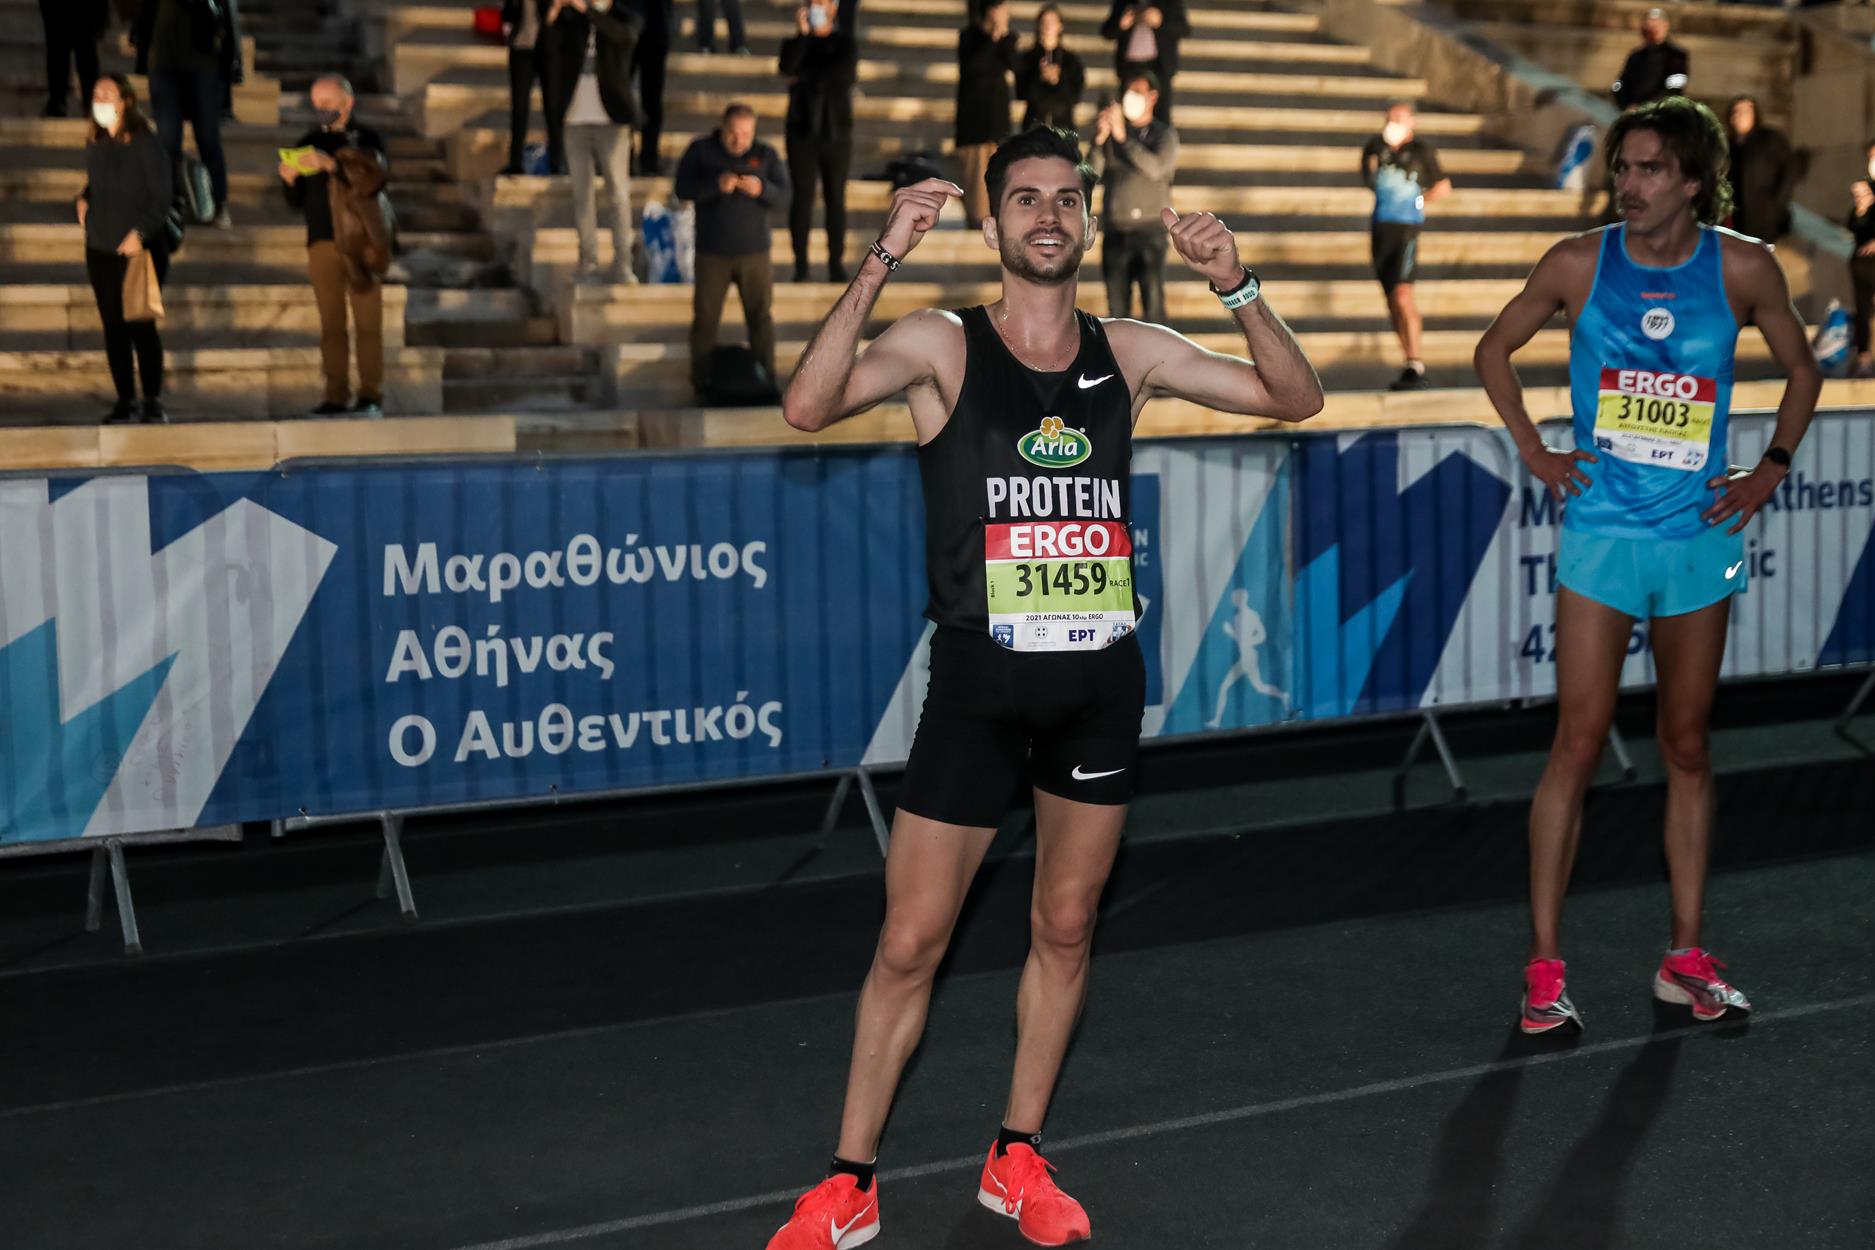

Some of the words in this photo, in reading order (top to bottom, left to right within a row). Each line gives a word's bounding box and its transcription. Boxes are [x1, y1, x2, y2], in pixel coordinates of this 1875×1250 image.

[1618, 370, 1698, 399] ERGO
[1618, 395, 1690, 427] 31003
[1031, 436, 1078, 456] Arla
[986, 476, 1121, 519] PROTEIN
[1010, 524, 1110, 557] ERGO
[383, 534, 767, 603] Μαραθώνιος
[1016, 562, 1107, 597] 31459
[386, 624, 615, 688] Αθήνας
[454, 690, 783, 762] Αυθεντικός
